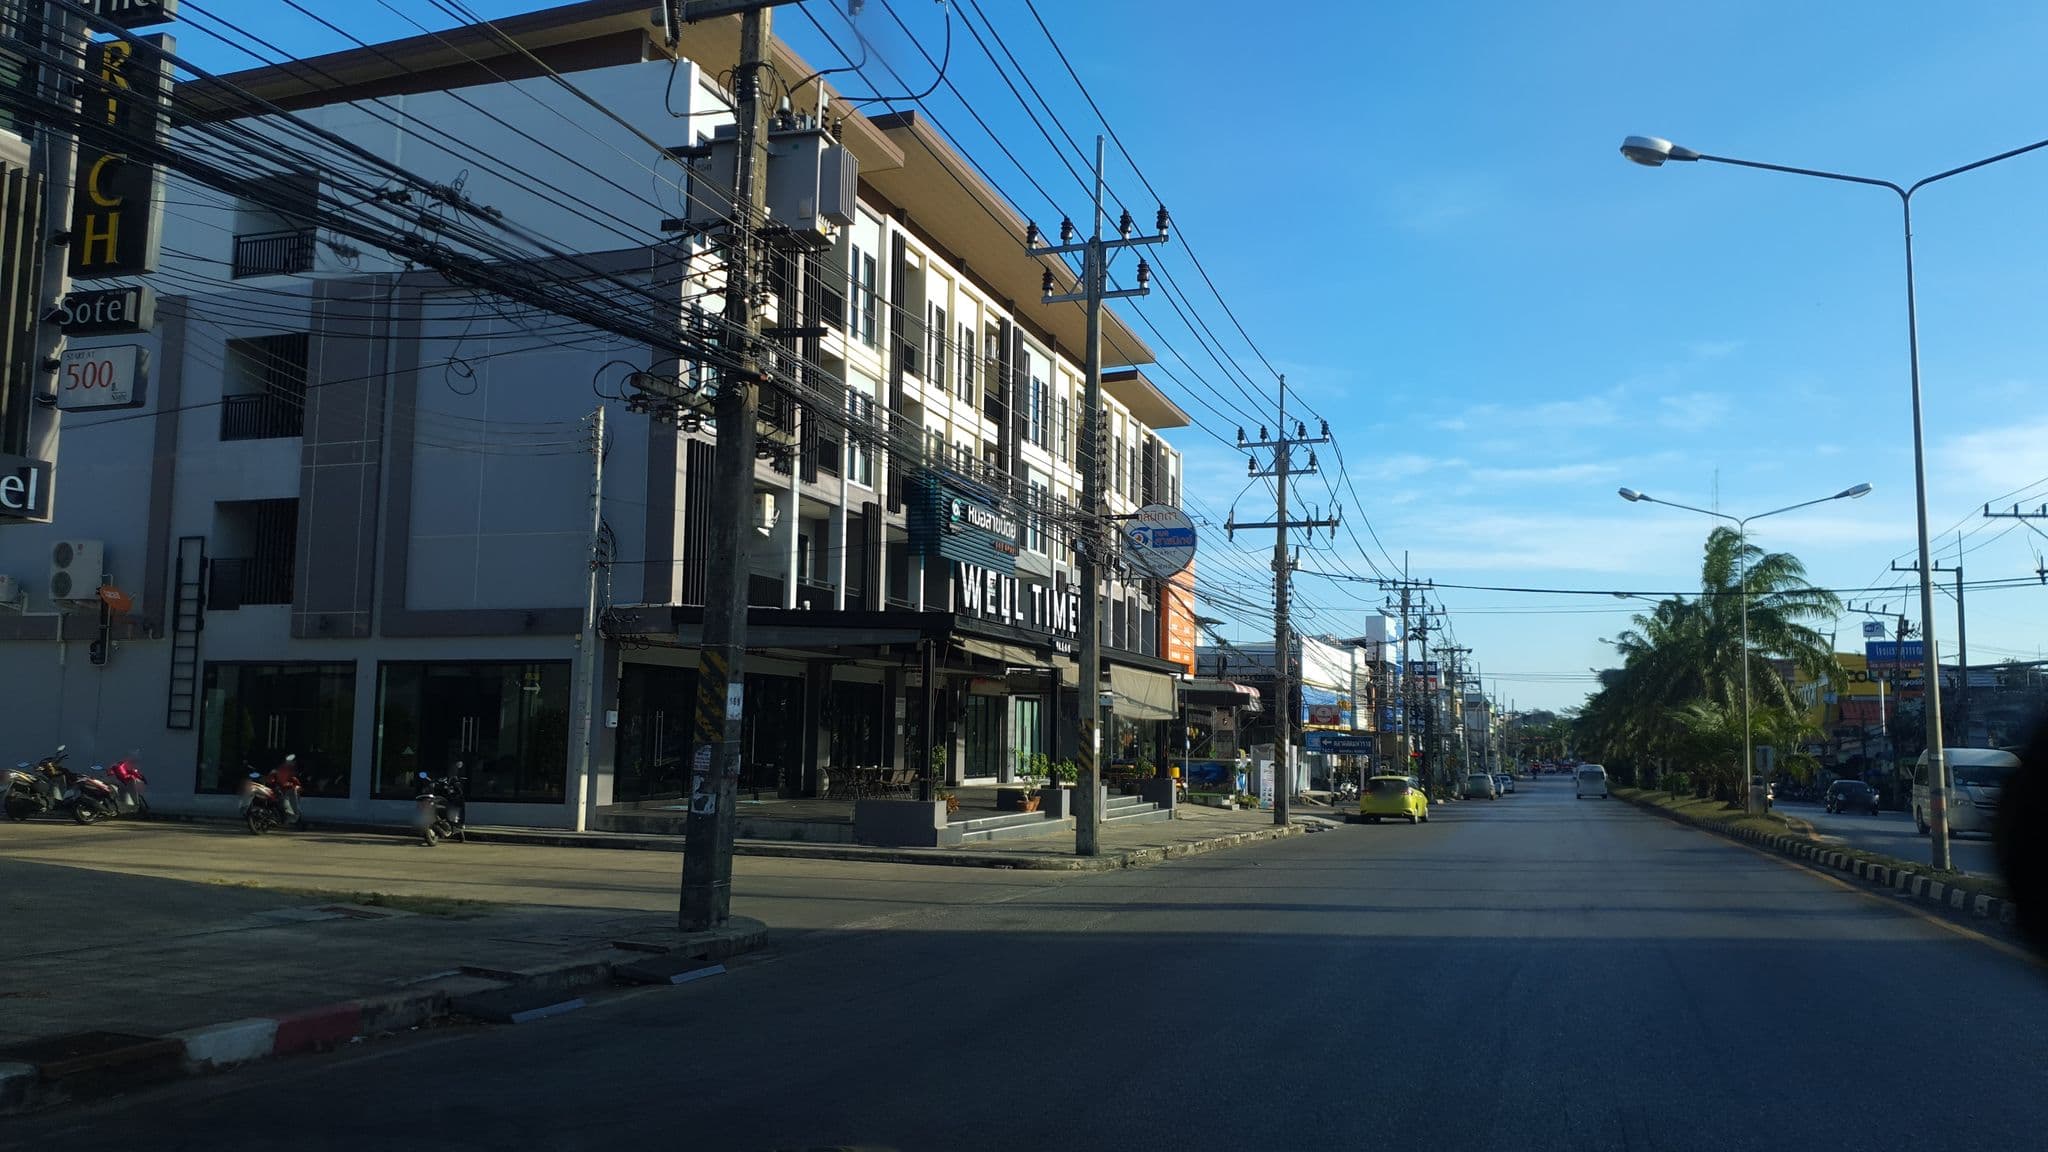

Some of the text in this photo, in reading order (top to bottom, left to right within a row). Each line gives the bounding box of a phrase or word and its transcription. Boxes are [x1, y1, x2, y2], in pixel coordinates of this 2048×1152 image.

[81, 39, 133, 267] RICH
[59, 291, 137, 325] Sotel
[66, 352, 95, 361] START AT
[66, 360, 114, 390] 500
[960, 561, 1024, 621] WELL
